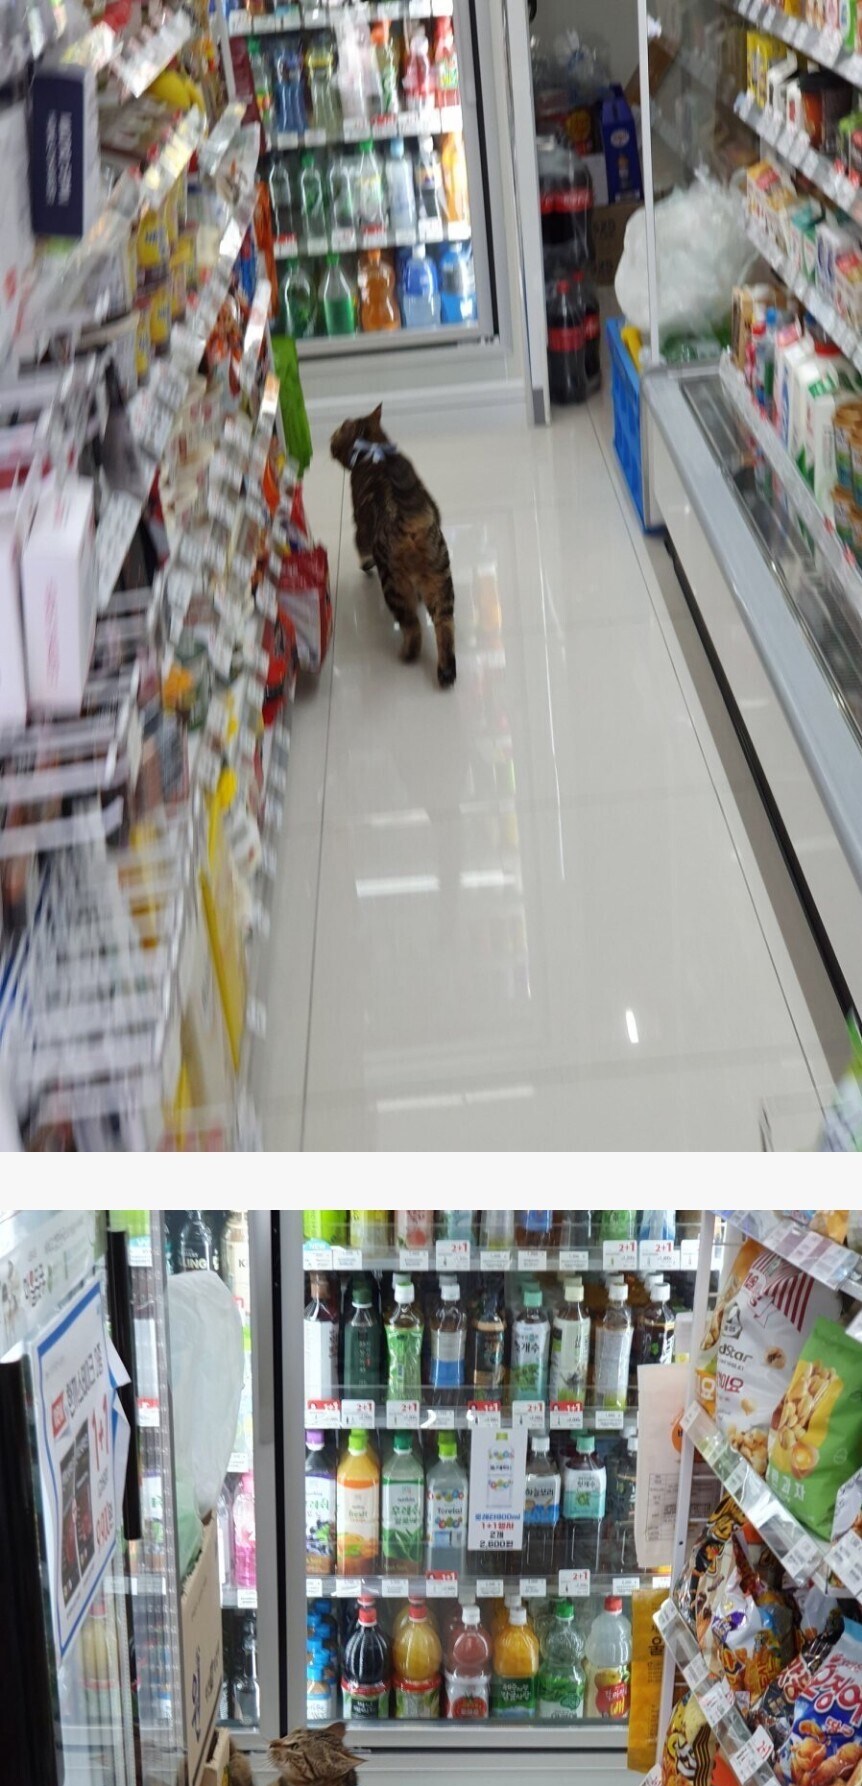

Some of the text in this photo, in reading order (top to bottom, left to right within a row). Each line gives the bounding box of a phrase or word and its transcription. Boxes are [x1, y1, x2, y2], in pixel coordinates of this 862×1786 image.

[451, 1242, 468, 1252] 2+1
[619, 1242, 635, 1252] 2+1
[655, 1242, 672, 1252] 2+1
[527, 1402, 543, 1412] 2+1
[573, 1571, 588, 1581] 2+1
